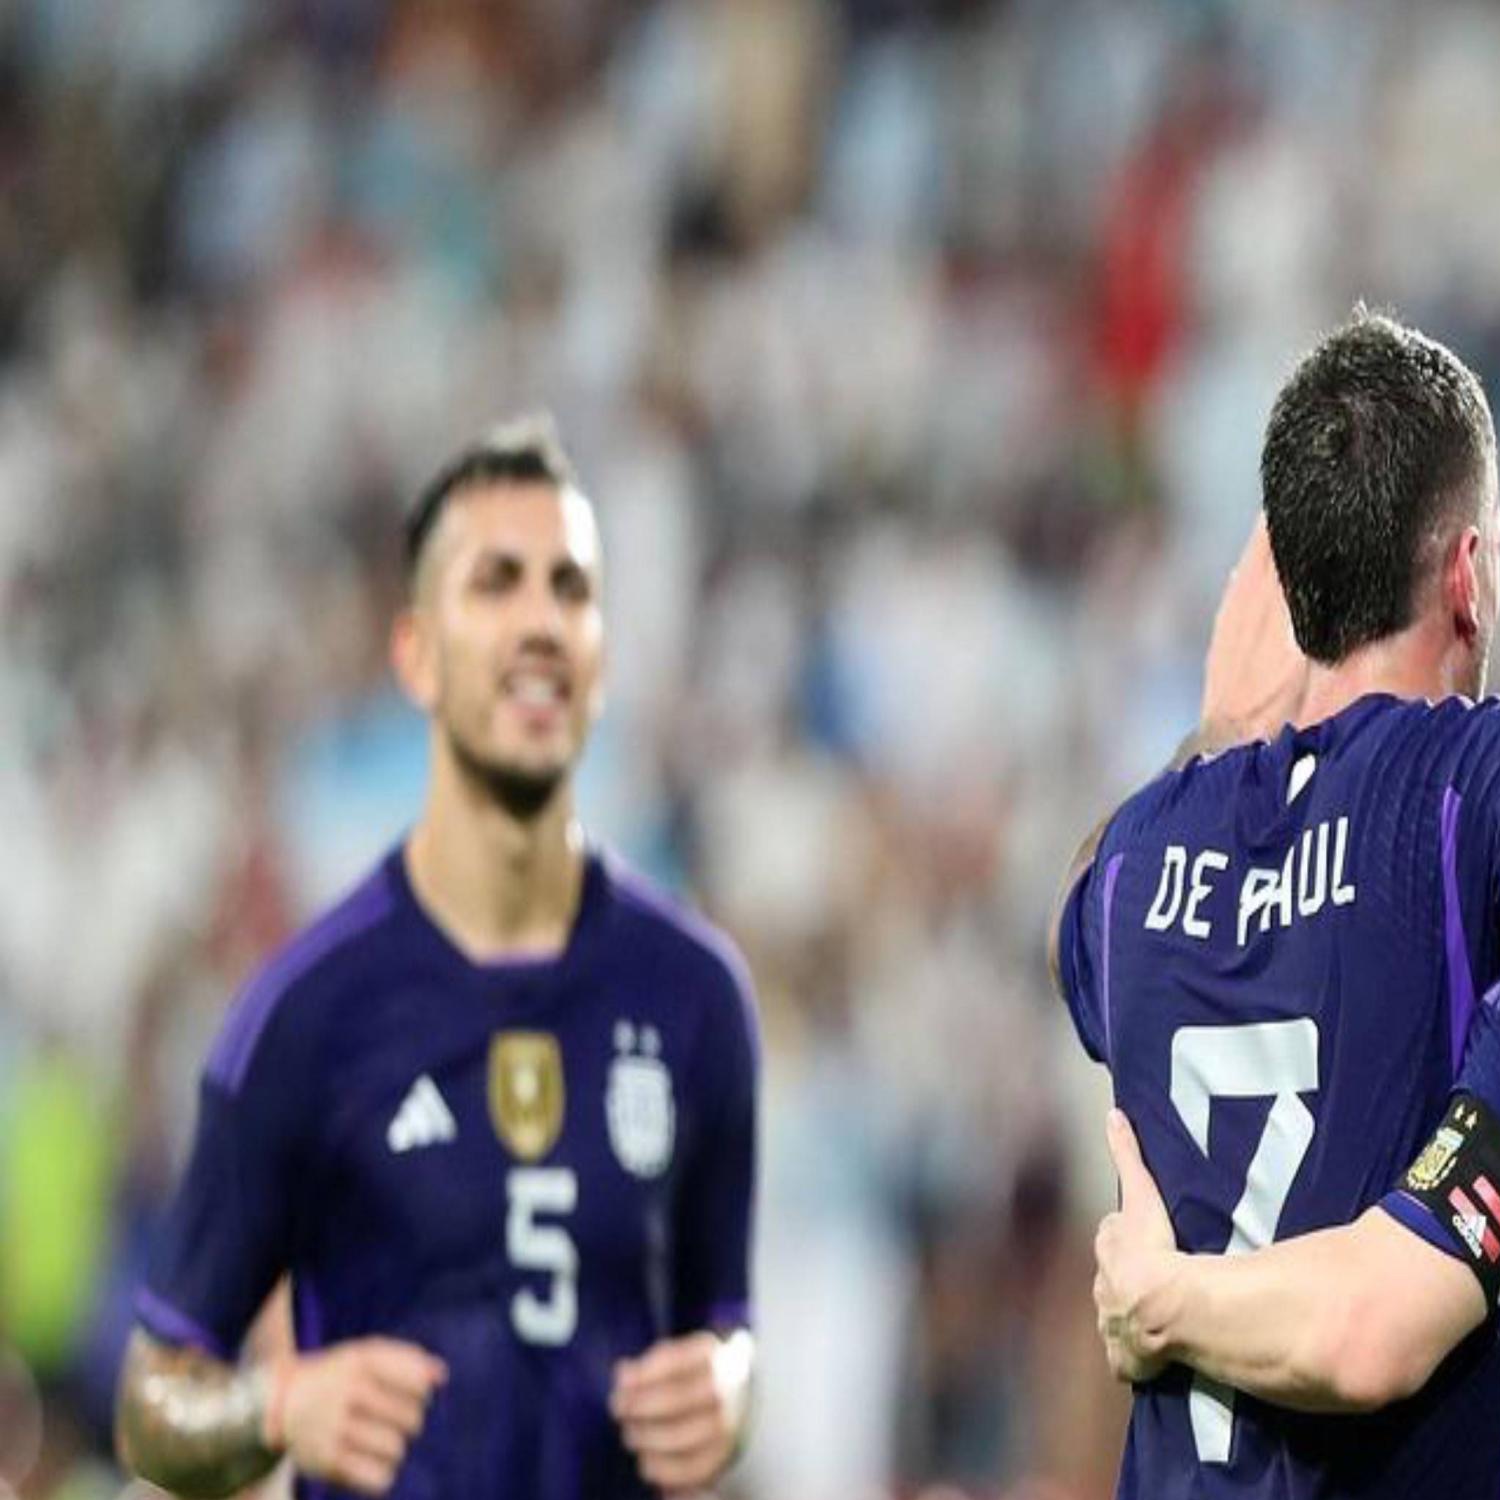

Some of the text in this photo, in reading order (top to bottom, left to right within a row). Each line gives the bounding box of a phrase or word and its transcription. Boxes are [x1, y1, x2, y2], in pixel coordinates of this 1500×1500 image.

[1144, 816, 1356, 946] DE PAUL
[506, 1166, 579, 1347] 5
[1169, 1017, 1319, 1463] 7
